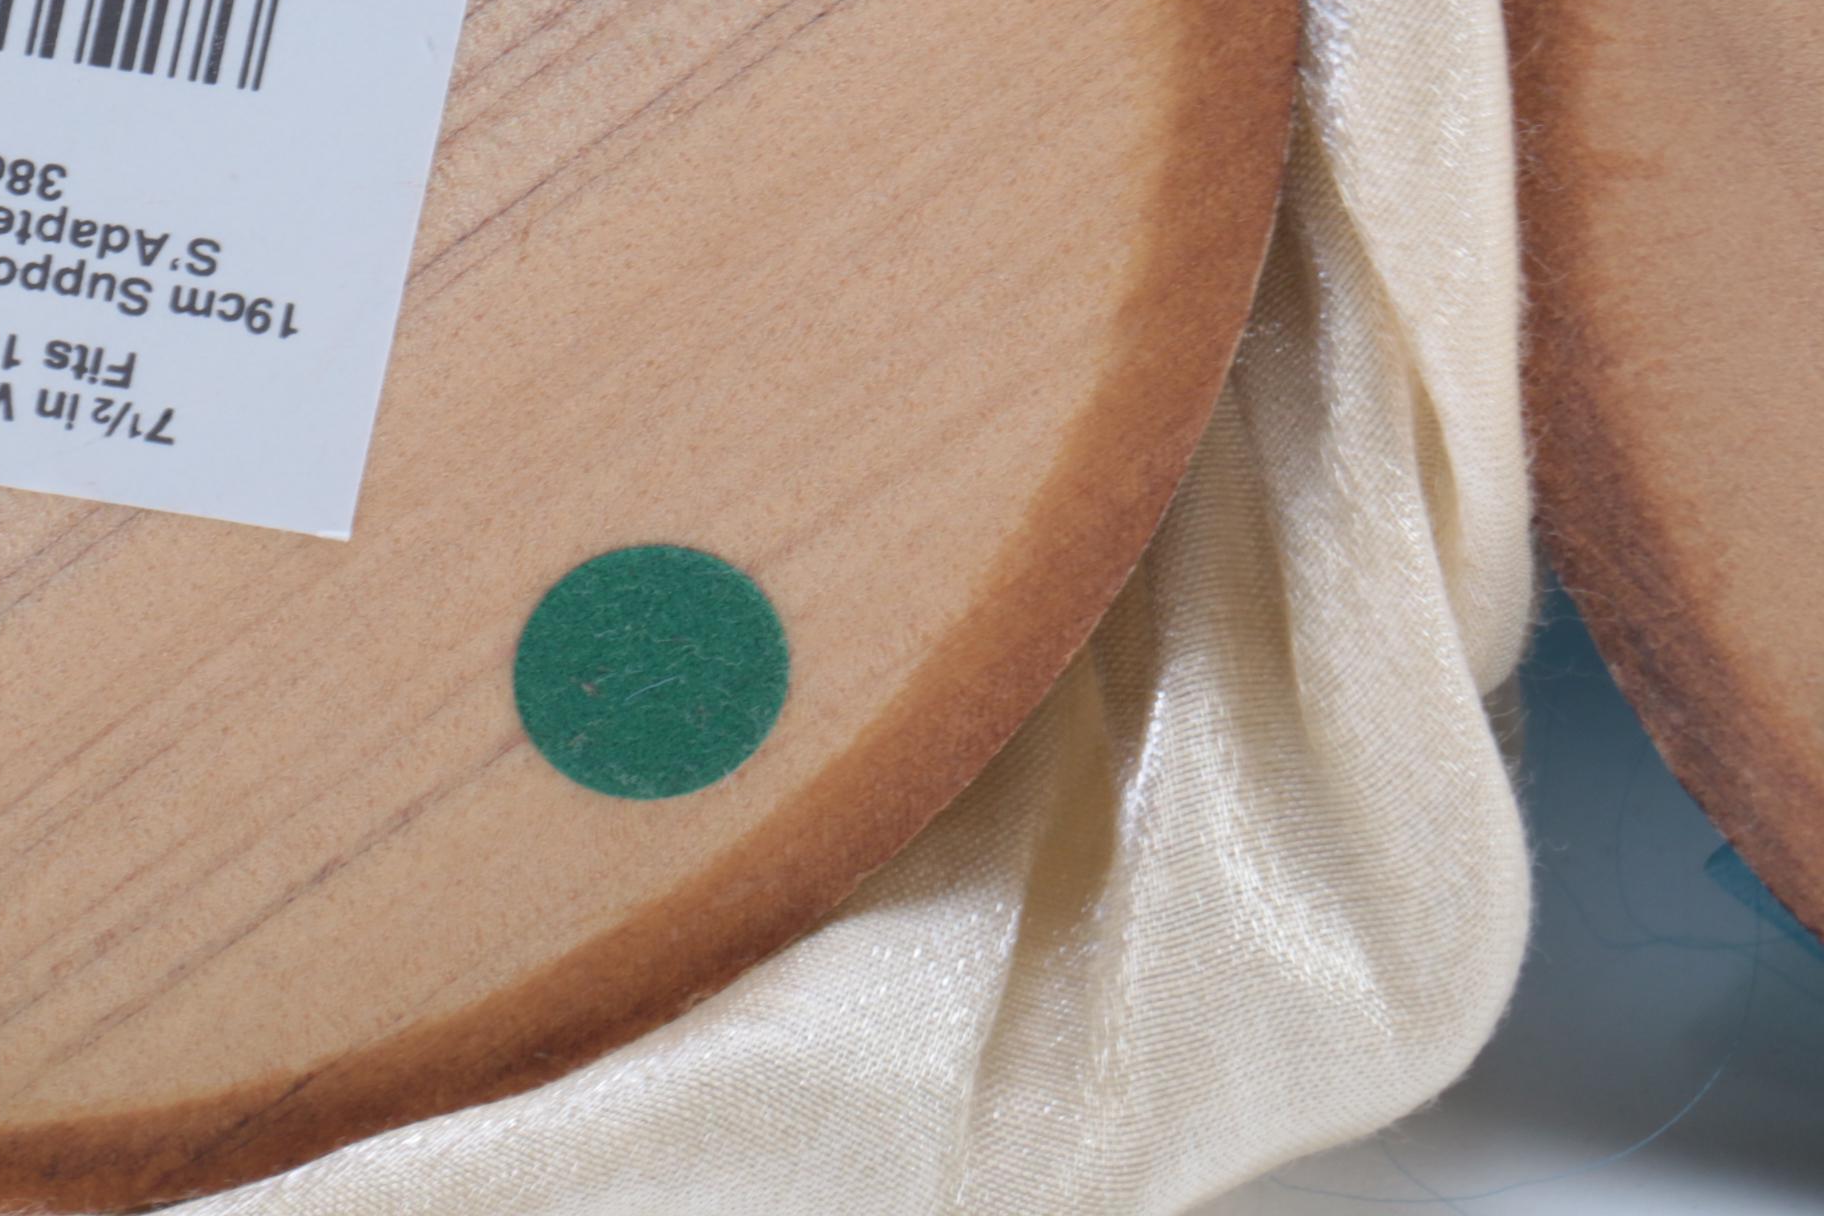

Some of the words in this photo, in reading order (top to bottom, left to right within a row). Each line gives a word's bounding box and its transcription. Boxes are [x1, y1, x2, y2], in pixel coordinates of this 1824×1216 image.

[167, 283, 299, 340] 19cm
[42, 337, 138, 391] Fits
[33, 386, 81, 431] in
